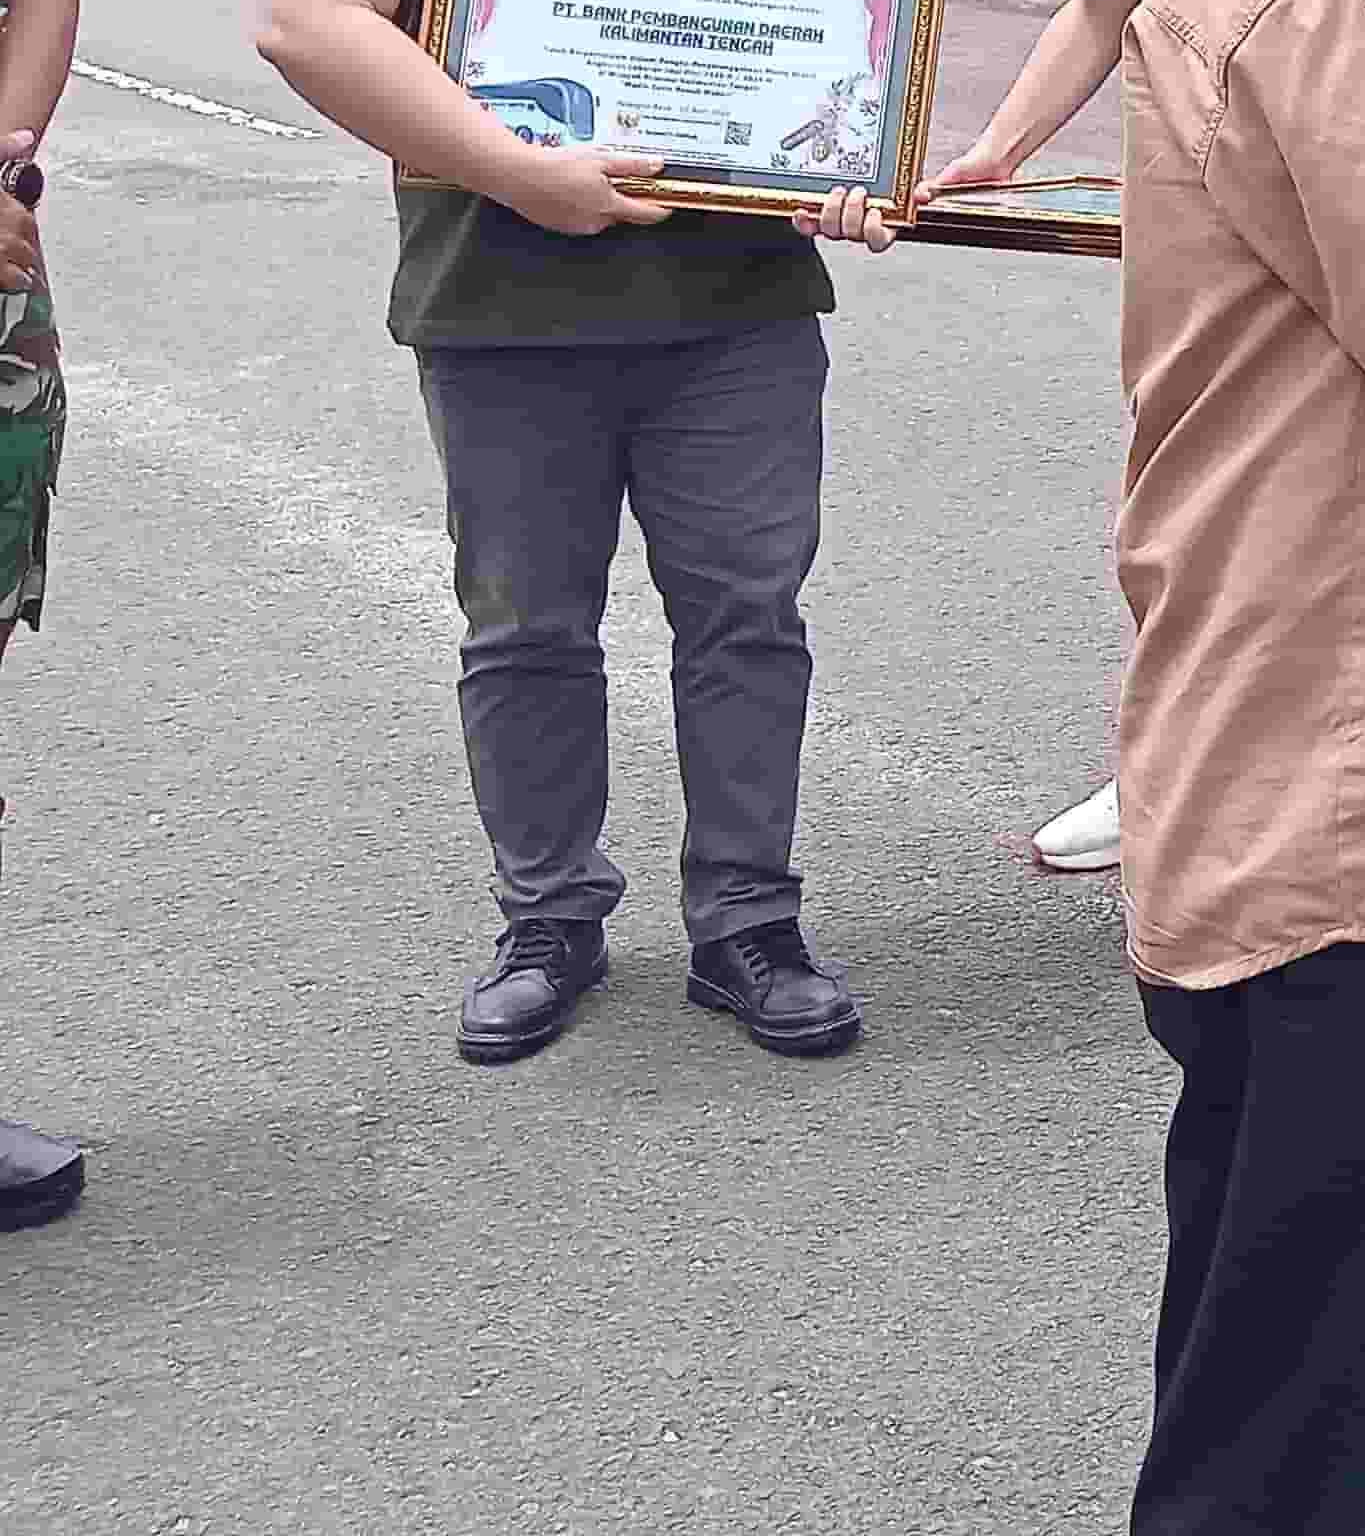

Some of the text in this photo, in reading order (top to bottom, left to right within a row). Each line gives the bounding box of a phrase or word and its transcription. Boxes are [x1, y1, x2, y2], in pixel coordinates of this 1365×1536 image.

[582, 4, 629, 23] BANK
[631, 9, 754, 35] PEMBANGUNAN
[759, 22, 825, 44] DAERAH
[600, 24, 775, 56] KALIMANTAN TENGAH
